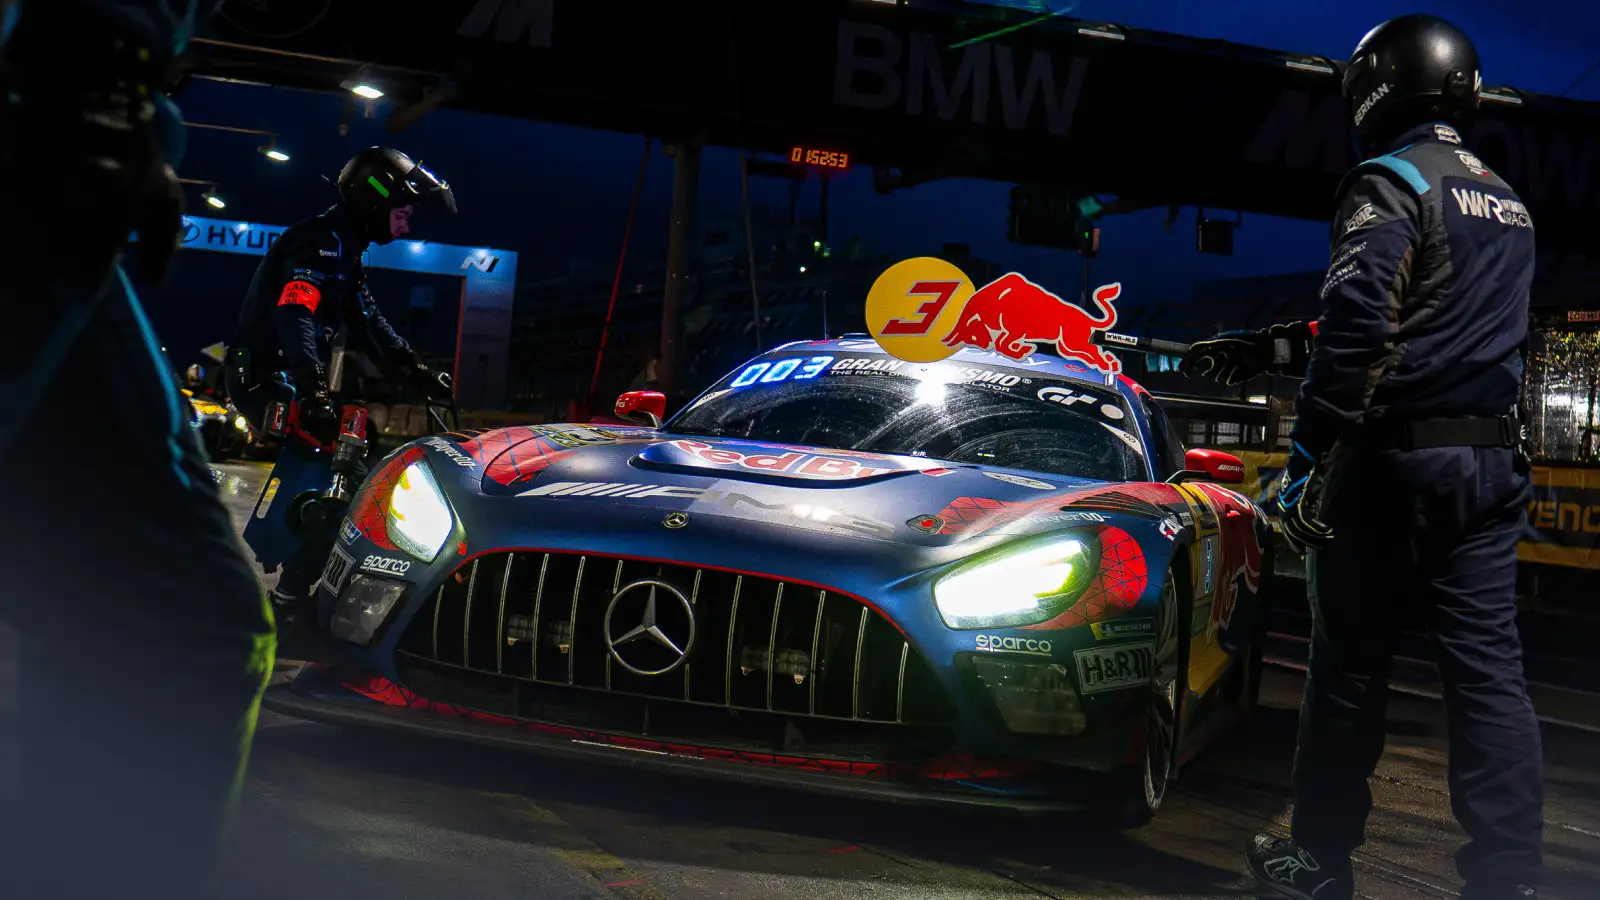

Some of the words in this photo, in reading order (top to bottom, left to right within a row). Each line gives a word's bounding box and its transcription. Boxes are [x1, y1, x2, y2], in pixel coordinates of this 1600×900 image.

[831, 18, 1091, 138] BMW
[879, 280, 963, 336] 3
[730, 356, 834, 387] 003
[831, 359, 906, 371] GRAN
[668, 440, 803, 471] Red
[363, 554, 411, 573] sparco
[975, 633, 1051, 653] sparco
